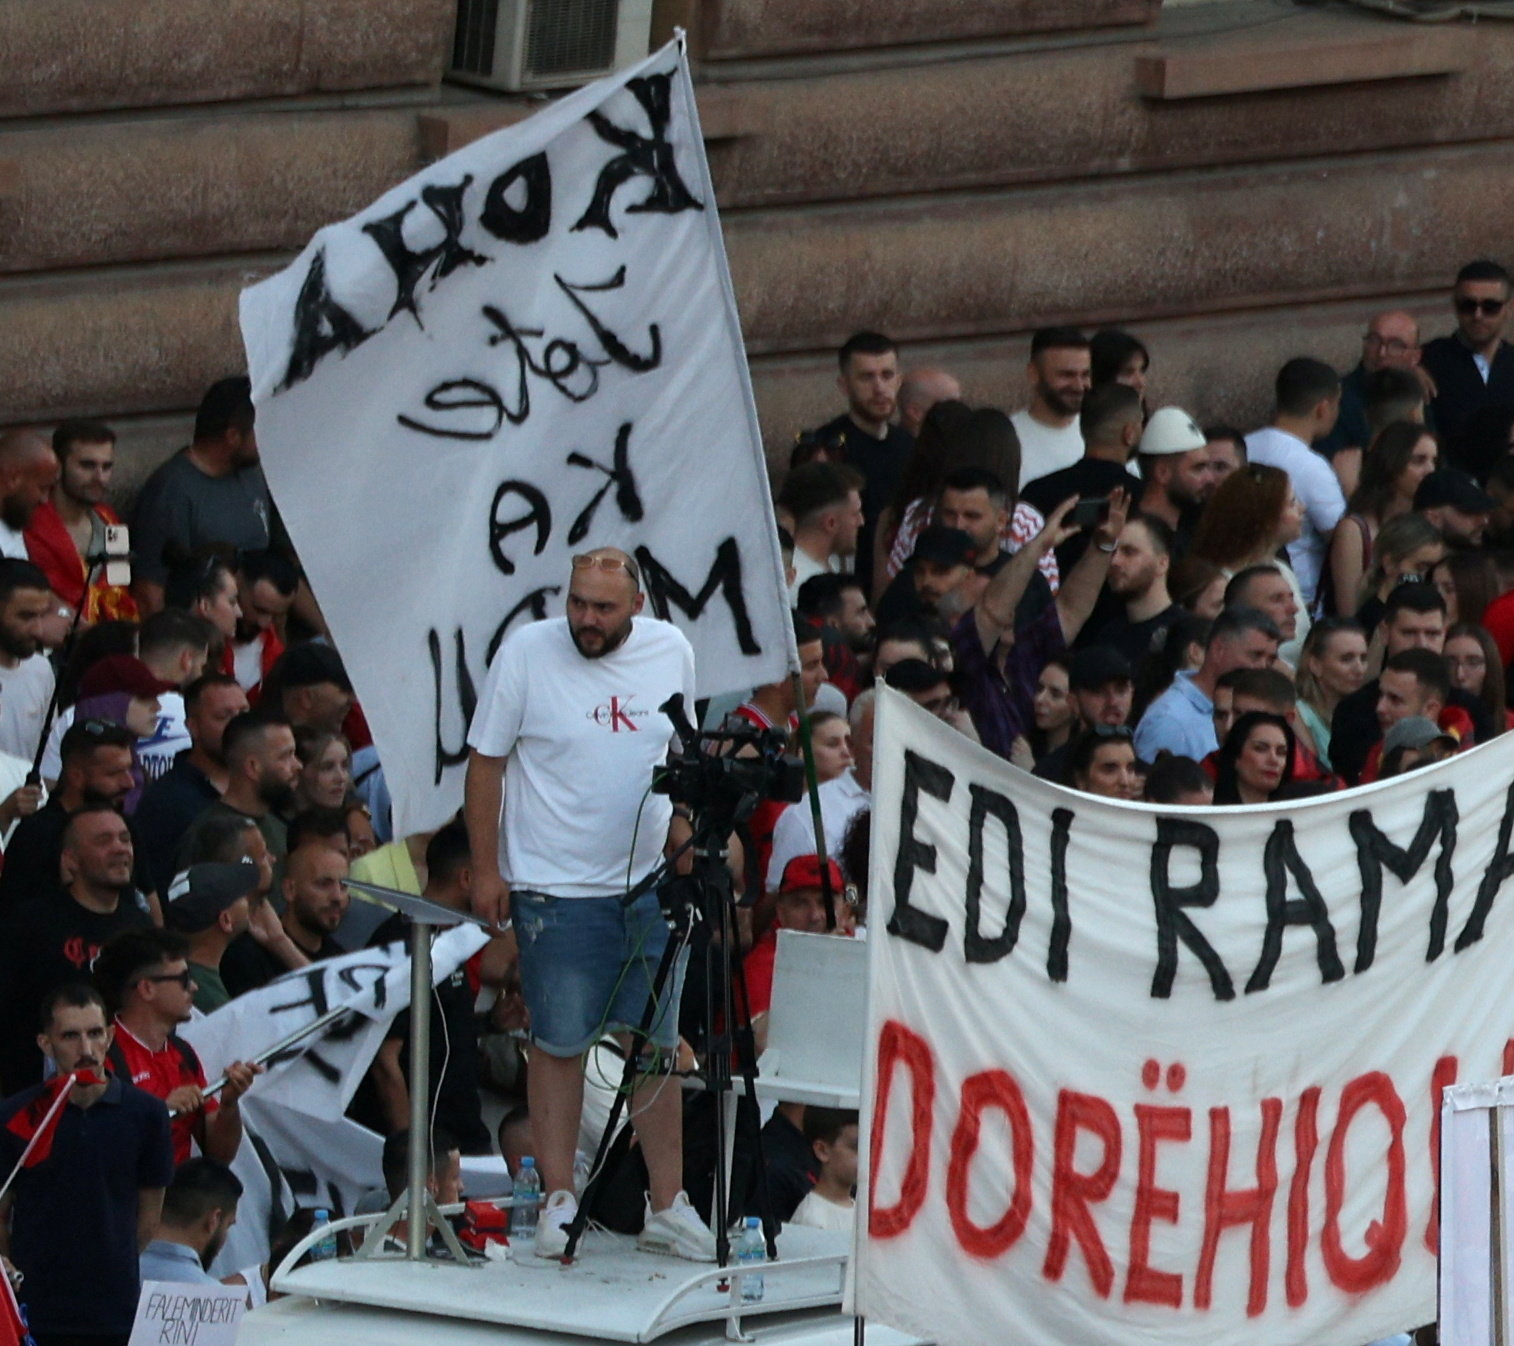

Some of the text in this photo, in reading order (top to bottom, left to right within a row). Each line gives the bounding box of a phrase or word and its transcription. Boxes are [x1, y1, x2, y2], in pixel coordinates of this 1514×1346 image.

[887, 748, 1075, 983] EDI
[146, 1293, 243, 1325] FALEMINDERIT
[160, 1318, 197, 1346] RINI
